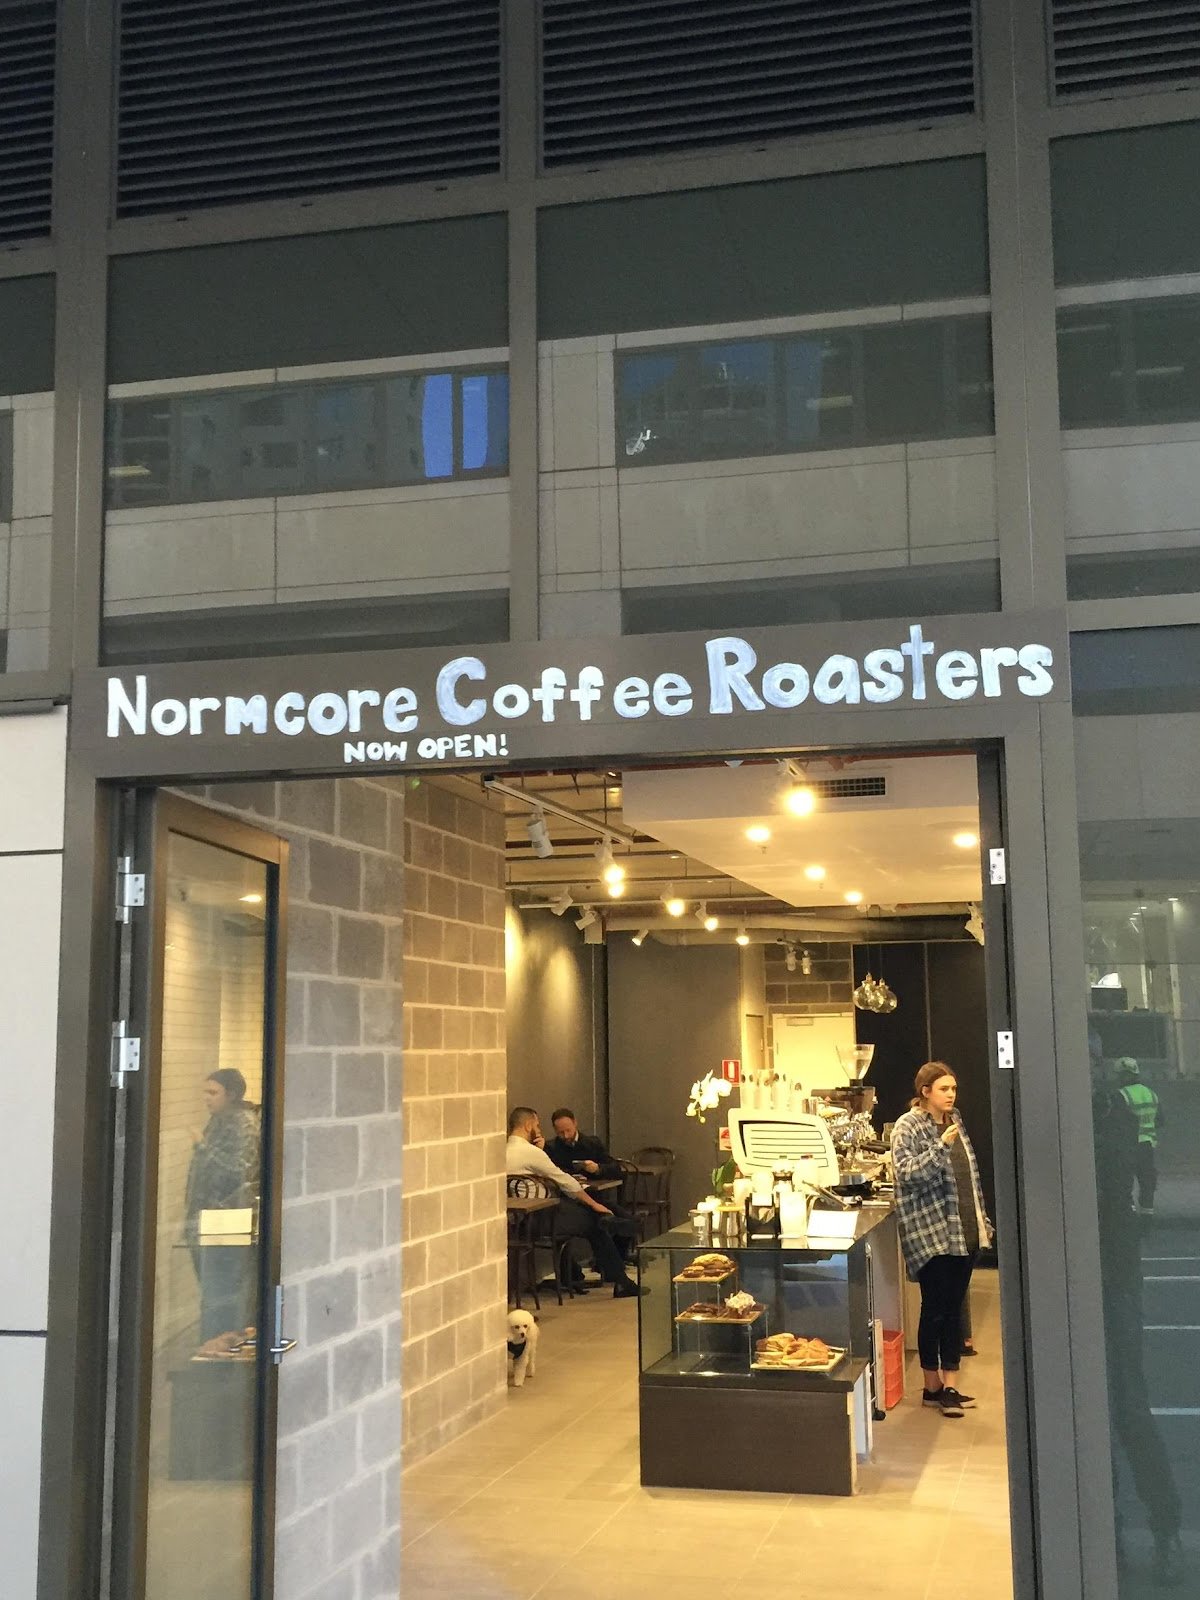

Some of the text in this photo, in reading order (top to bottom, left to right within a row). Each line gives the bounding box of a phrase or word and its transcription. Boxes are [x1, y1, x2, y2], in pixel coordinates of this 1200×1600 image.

[106, 624, 1054, 738] Normcore Coffee Roasters
[343, 733, 509, 764] NOW OPEN!
